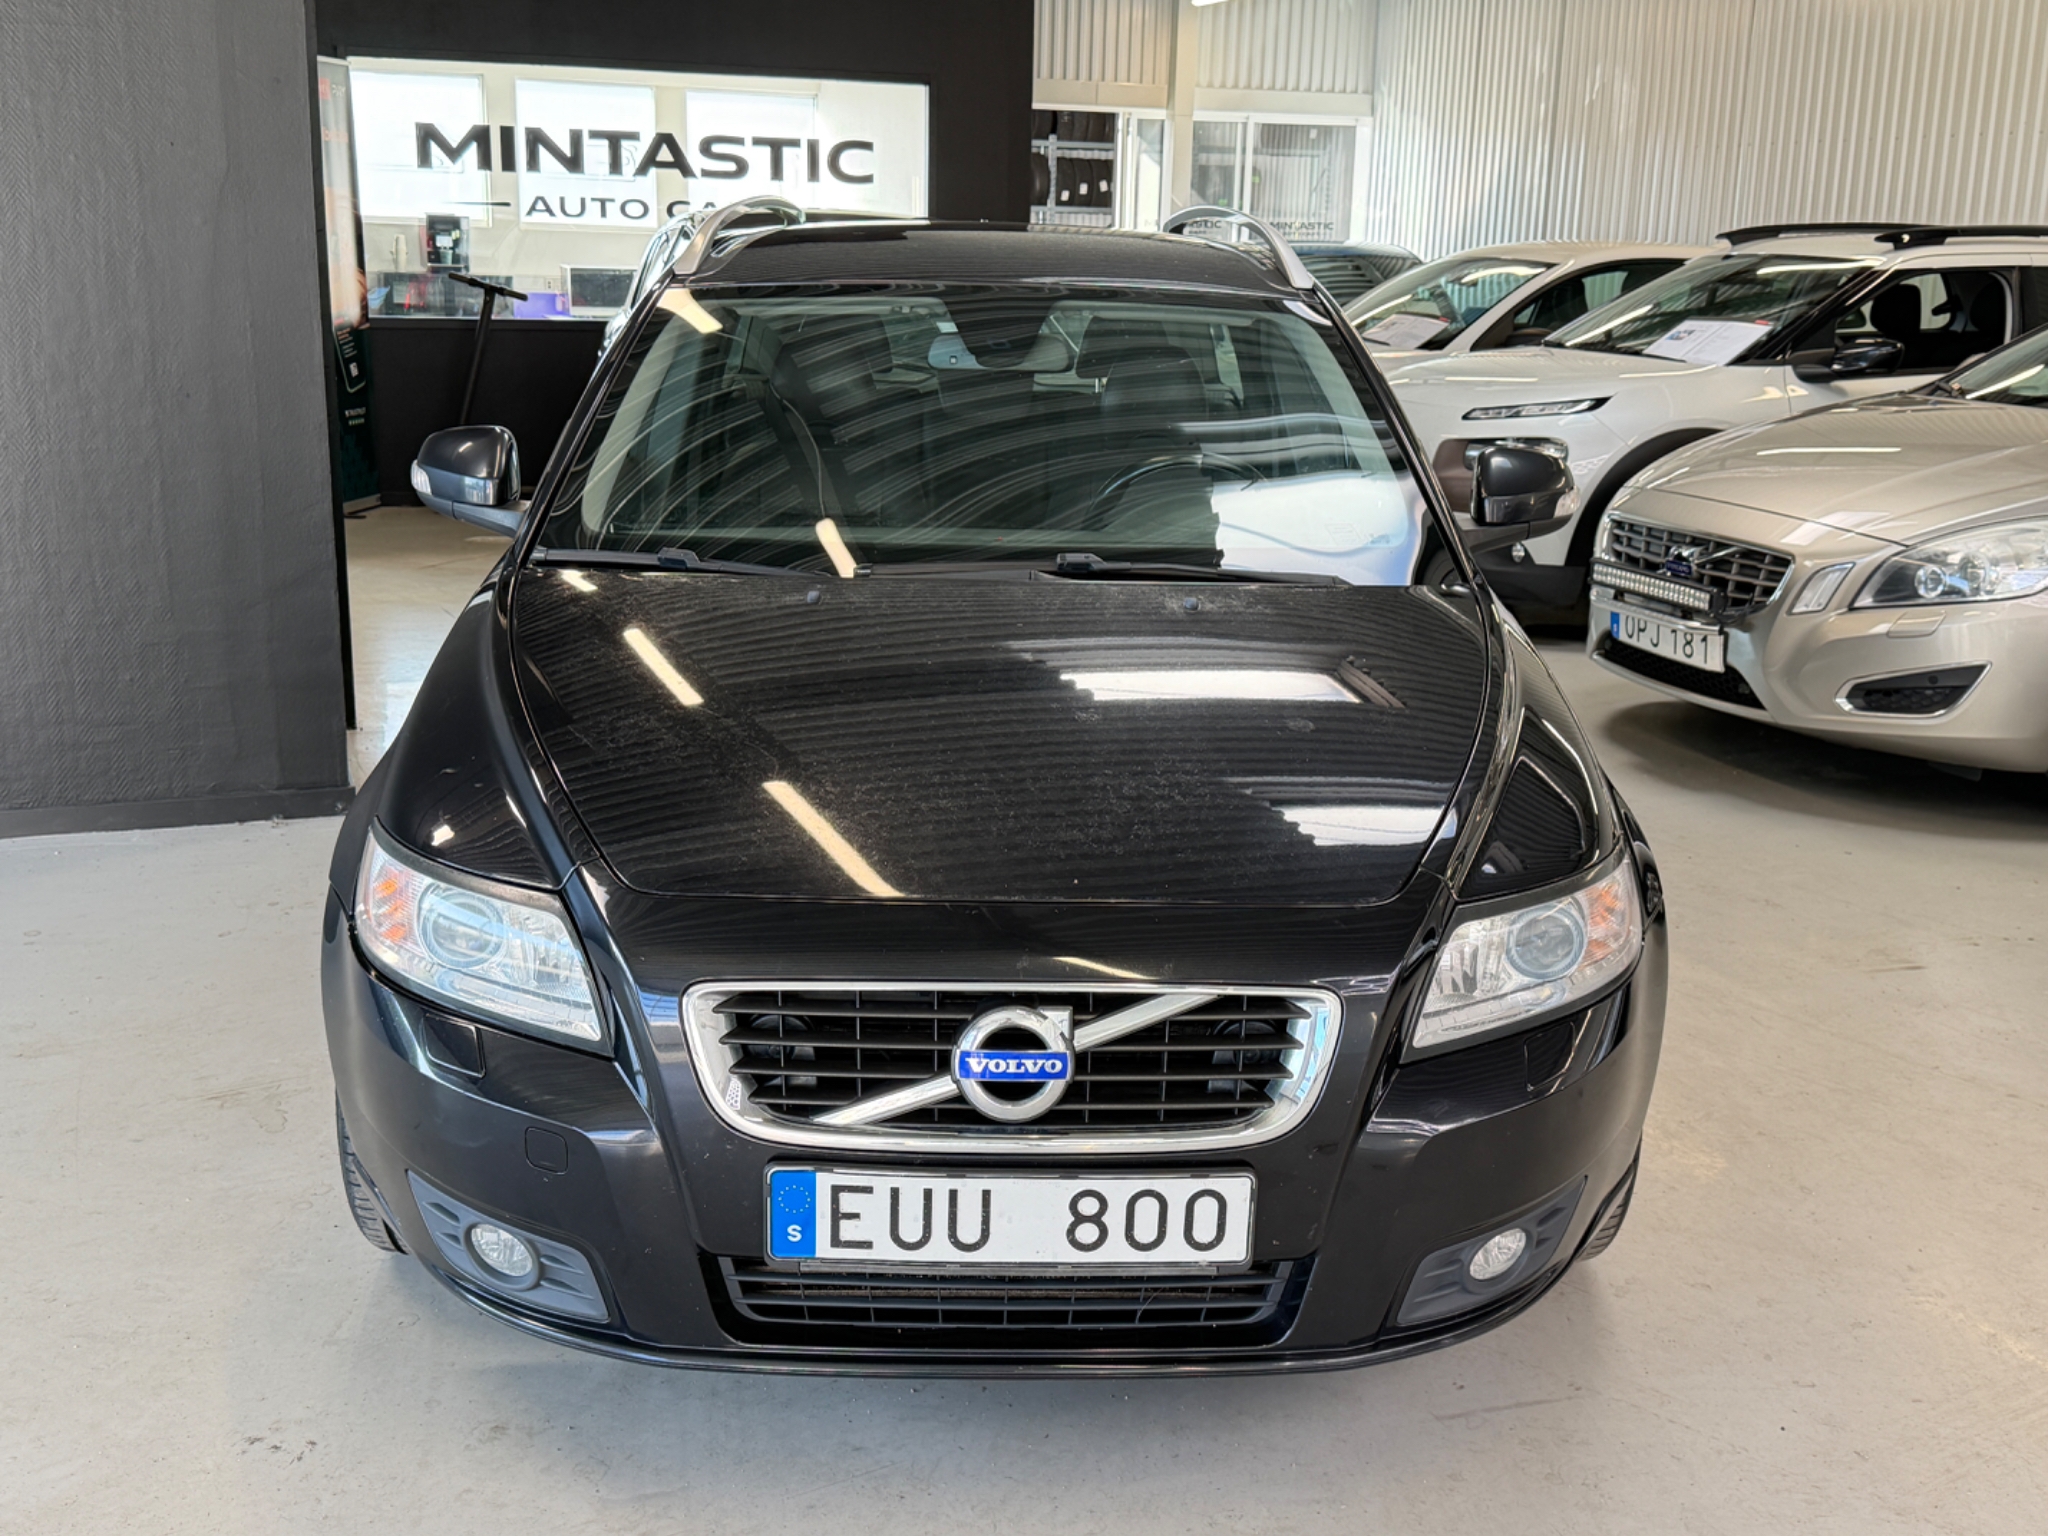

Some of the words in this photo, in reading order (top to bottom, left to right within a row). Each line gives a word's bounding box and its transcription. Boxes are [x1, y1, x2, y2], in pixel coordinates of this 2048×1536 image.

[414, 121, 875, 185] MINTASTIC
[525, 195, 650, 220] AUTO
[1670, 628, 1708, 664] 181
[964, 1057, 1064, 1074] VOLVO
[786, 1225, 802, 1242] S
[829, 1183, 992, 1252] EUU
[1066, 1188, 1228, 1252] 800
